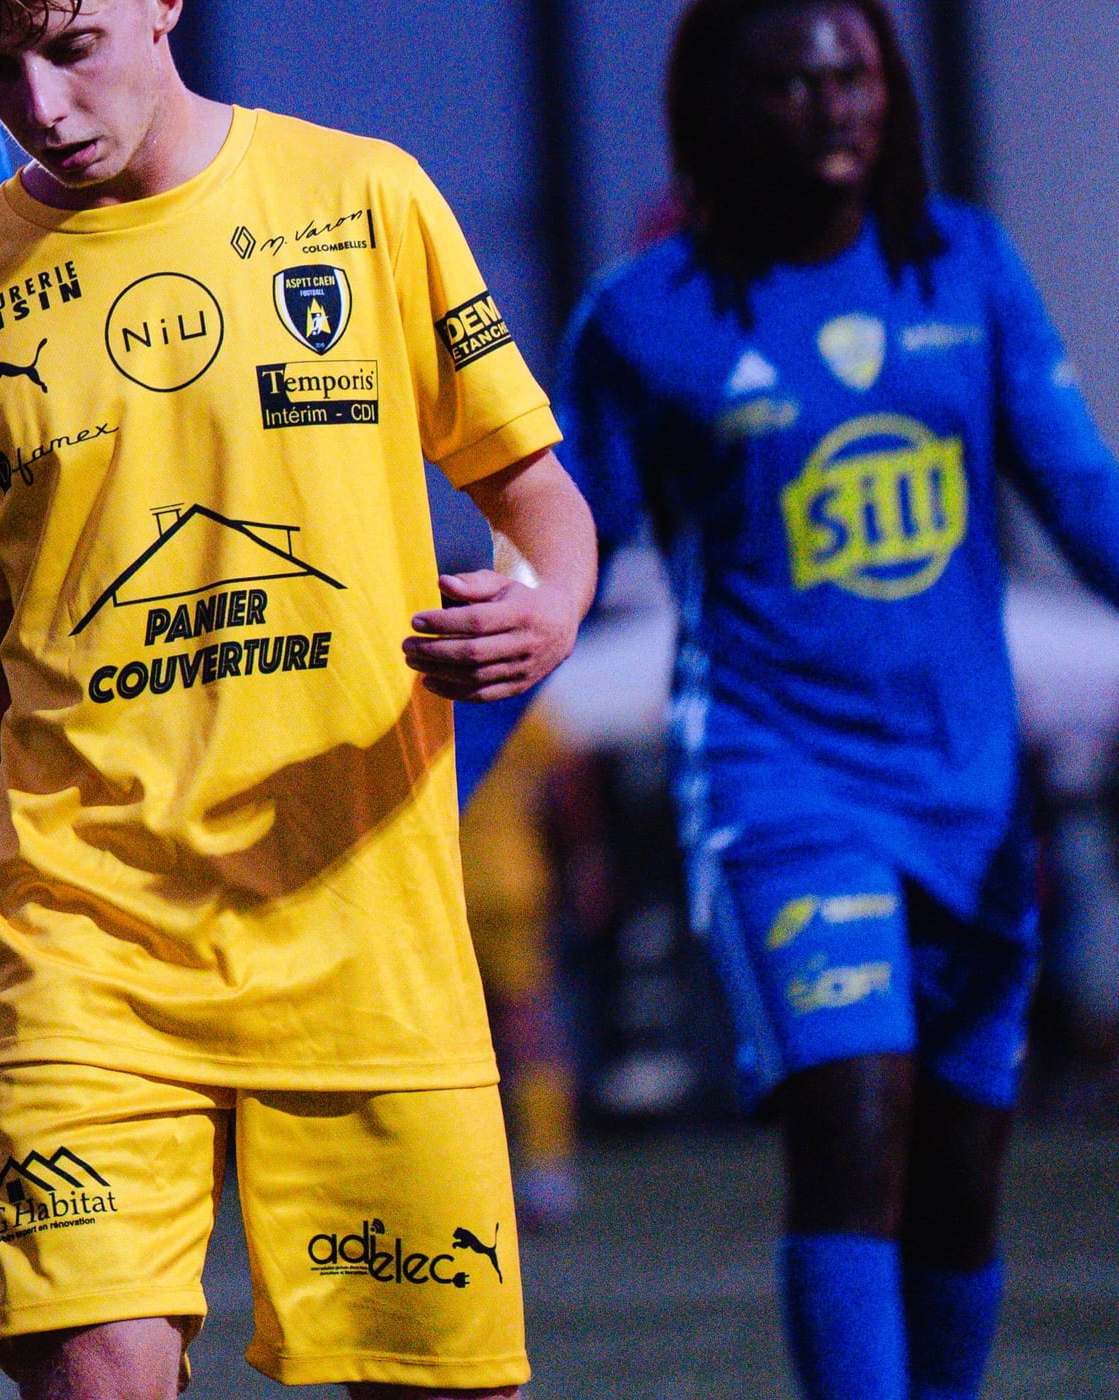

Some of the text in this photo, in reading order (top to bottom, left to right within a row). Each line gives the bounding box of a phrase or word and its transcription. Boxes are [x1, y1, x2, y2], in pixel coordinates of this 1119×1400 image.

[301, 240, 368, 254] COLOMBELLES
[285, 275, 336, 289] ASPTT CAEN
[261, 368, 375, 398] Temporis
[265, 405, 328, 426] Intérim
[351, 403, 376, 422] CDI
[144, 588, 268, 647] PANIER
[87, 631, 332, 704] COUVERTURE
[13, 1190, 118, 1229] Habitat
